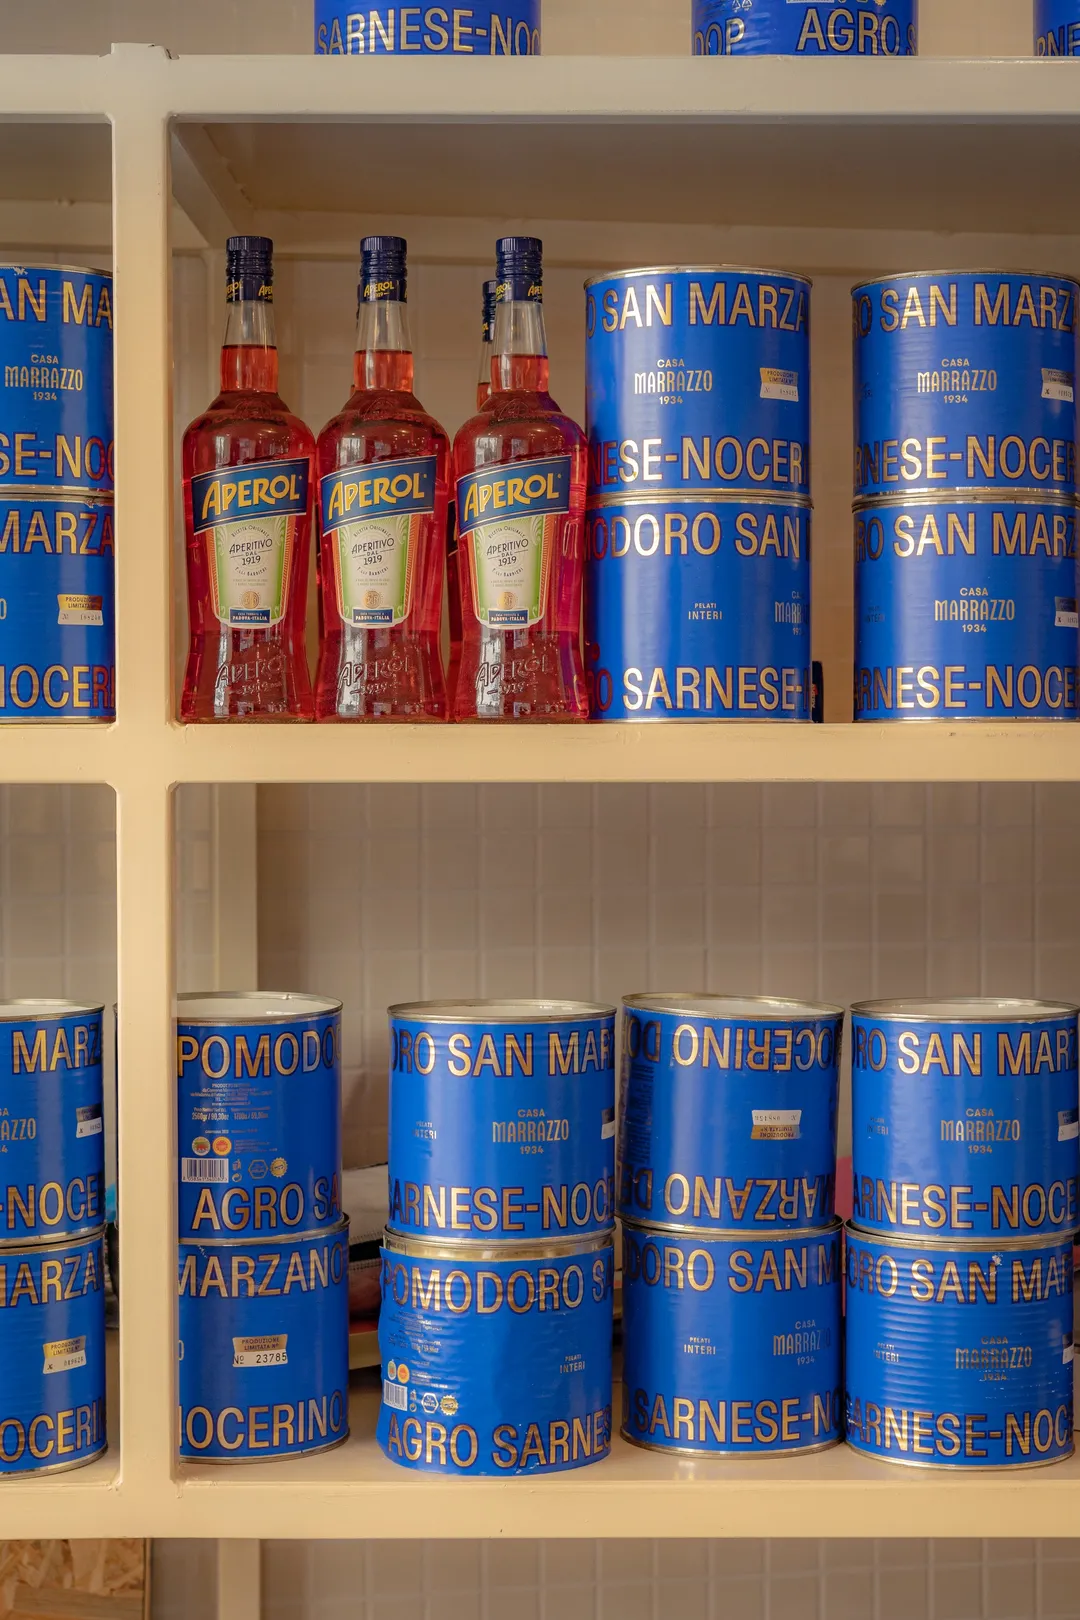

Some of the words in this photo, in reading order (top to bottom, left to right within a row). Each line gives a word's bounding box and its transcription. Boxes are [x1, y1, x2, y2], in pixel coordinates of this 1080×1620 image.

[796, 8, 899, 55] AGRO
[363, 280, 395, 298] APEROL
[602, 282, 672, 333] SAN
[879, 284, 957, 332] SAN
[31, 354, 59, 365] CASA
[657, 358, 684, 368] CASA
[941, 359, 970, 368] CASA
[5, 366, 84, 391] MARRAZZO
[634, 370, 713, 394] MARRAZZO
[917, 370, 997, 392] MARRAZZO
[33, 391, 57, 401] 1934
[659, 395, 683, 405] 1934
[943, 395, 968, 404] 1934
[202, 474, 300, 520] APEROL
[328, 471, 426, 521] APEROL
[463, 472, 561, 523] APEROL
[735, 512, 801, 558] SAN
[893, 512, 975, 557] SAN
[229, 538, 273, 554] APERITIVO
[352, 538, 395, 554] APERITIVO
[487, 539, 529, 556] APERITIVO
[242, 556, 261, 566] 1919
[363, 555, 382, 566] 1919
[498, 556, 517, 567] 1919
[960, 587, 988, 596] CASA
[688, 610, 722, 620] INTERI
[935, 599, 1015, 621] MARRAZZO
[962, 624, 986, 633] 1934
[622, 667, 809, 711] SARNESE-
[447, 1033, 533, 1077] SAN
[898, 1031, 981, 1076] SAN
[518, 1109, 545, 1118] CASA
[966, 1108, 994, 1117] CASA
[492, 1119, 569, 1143] MARRAZZO
[941, 1119, 1020, 1142] MARRAZZO
[520, 1146, 544, 1154] 1934
[968, 1145, 992, 1154] 1934
[192, 1183, 304, 1230] AGRO
[728, 1248, 808, 1293] SAN
[910, 1258, 996, 1304] SAN
[795, 1319, 816, 1330] CASA
[689, 1336, 711, 1344] PELATI
[981, 1336, 1008, 1345] CASA
[256, 1352, 287, 1363] 23785
[683, 1344, 716, 1355] INTERI
[797, 1355, 815, 1366] 1934
[955, 1346, 1033, 1370] MARRAZZO
[559, 1361, 586, 1374] INTERI
[179, 1391, 343, 1450] OCERINO
[388, 1413, 478, 1468] AGRO
